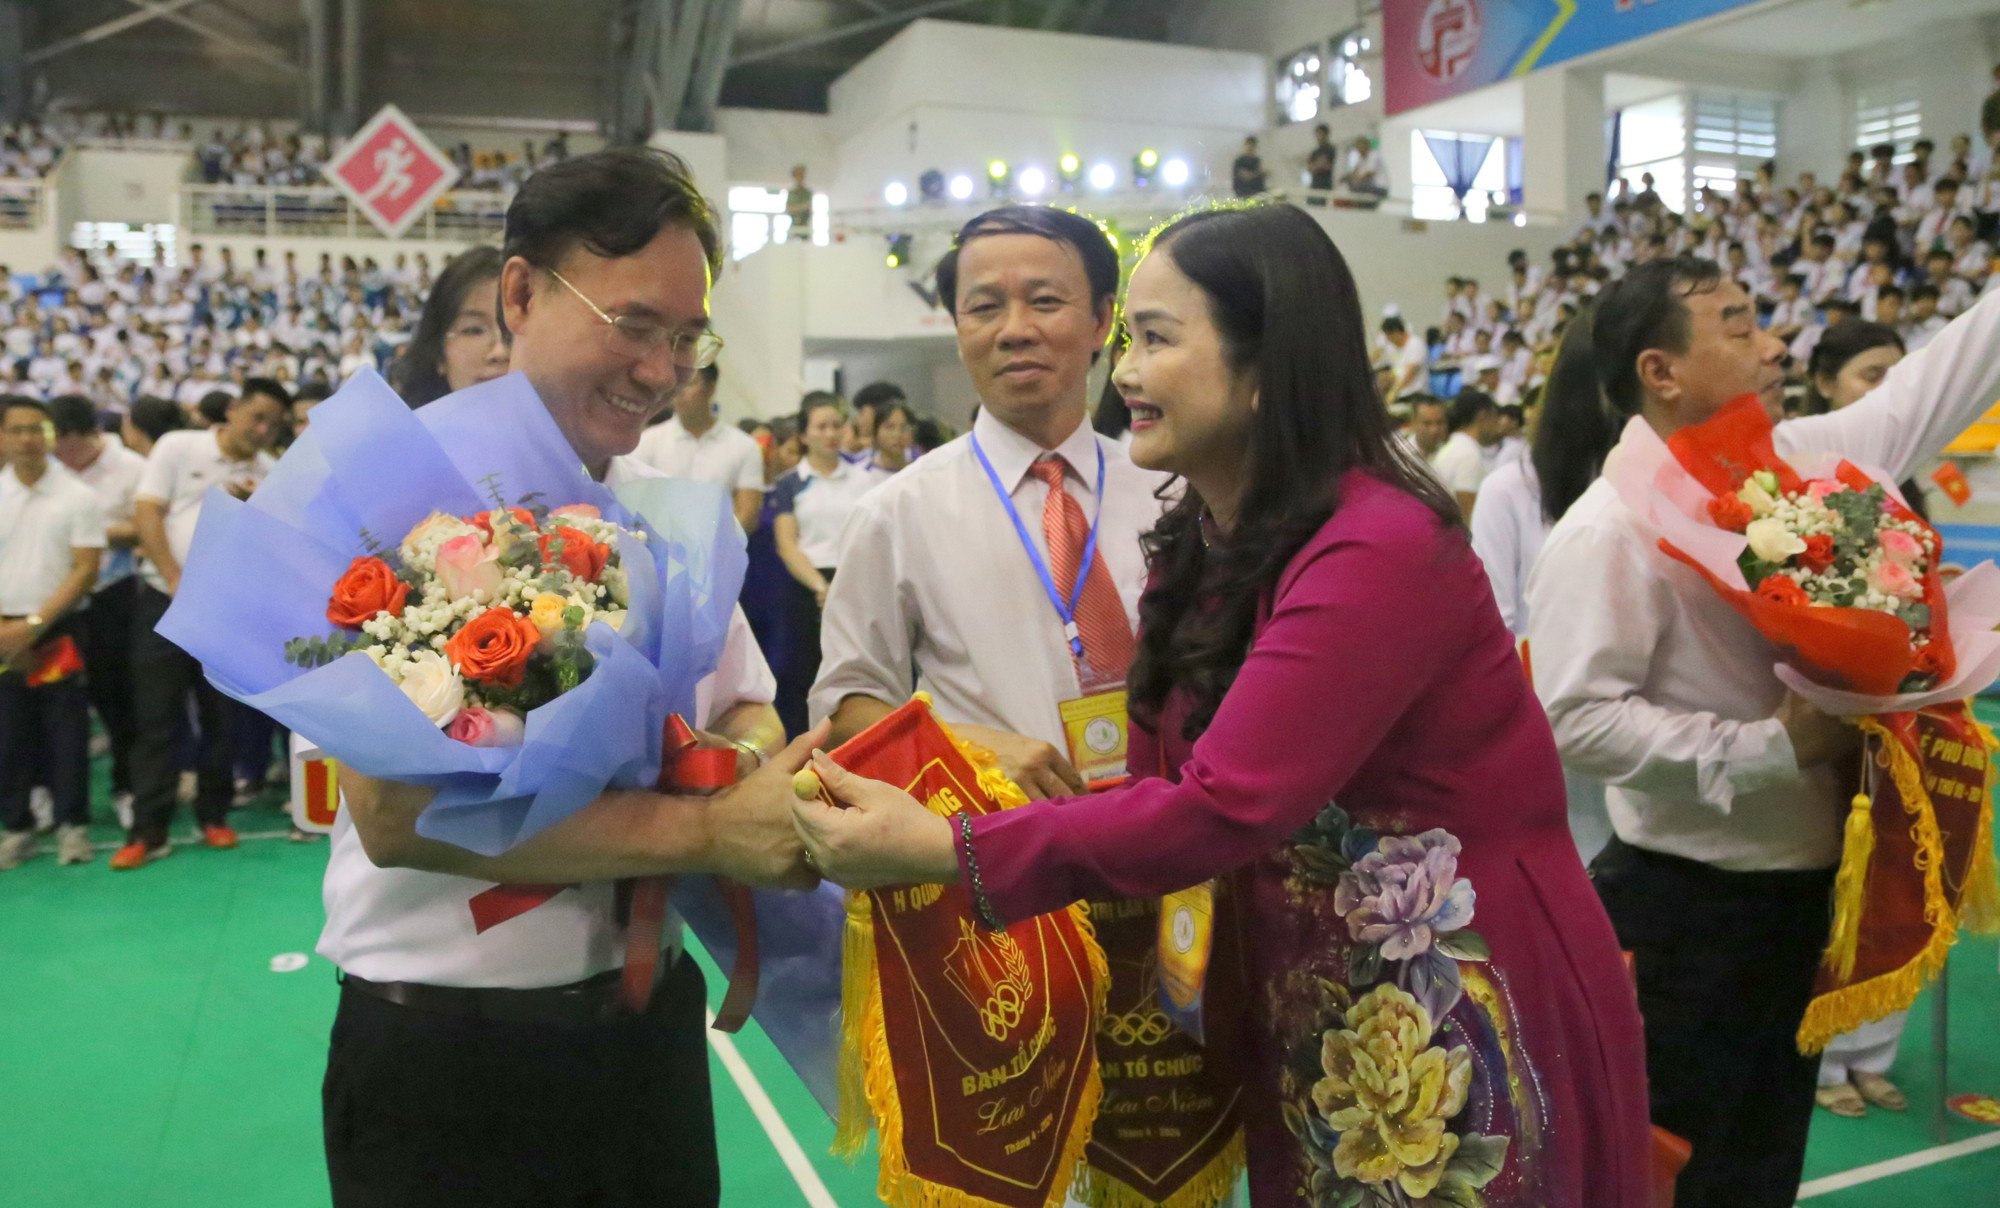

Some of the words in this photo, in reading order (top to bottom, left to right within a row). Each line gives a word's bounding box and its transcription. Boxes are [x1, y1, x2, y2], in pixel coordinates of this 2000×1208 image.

[923, 787, 963, 817] NG
[961, 1064, 1007, 1096] BAN
[1010, 1040, 1030, 1076] TỔ
[1153, 1053, 1203, 1077] CHỨC
